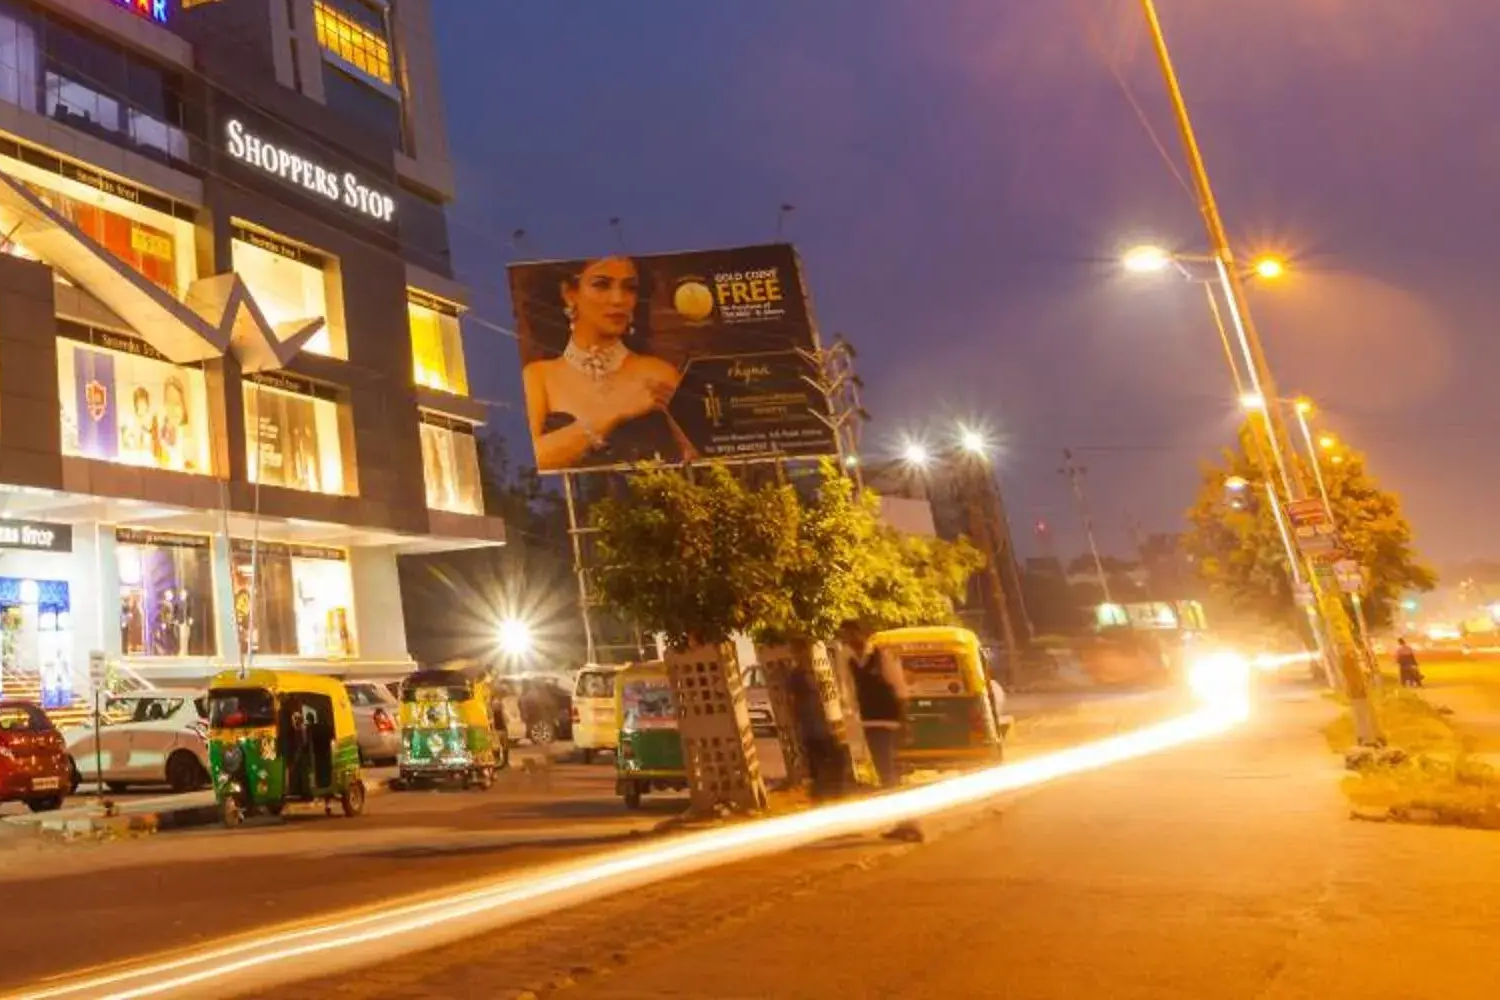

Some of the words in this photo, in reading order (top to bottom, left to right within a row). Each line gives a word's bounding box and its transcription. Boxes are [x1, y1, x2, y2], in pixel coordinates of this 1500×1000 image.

[227, 119, 339, 201] SHOPPERS
[343, 172, 395, 222] STOP
[716, 280, 784, 305] FREE
[22, 526, 55, 547] STOP
